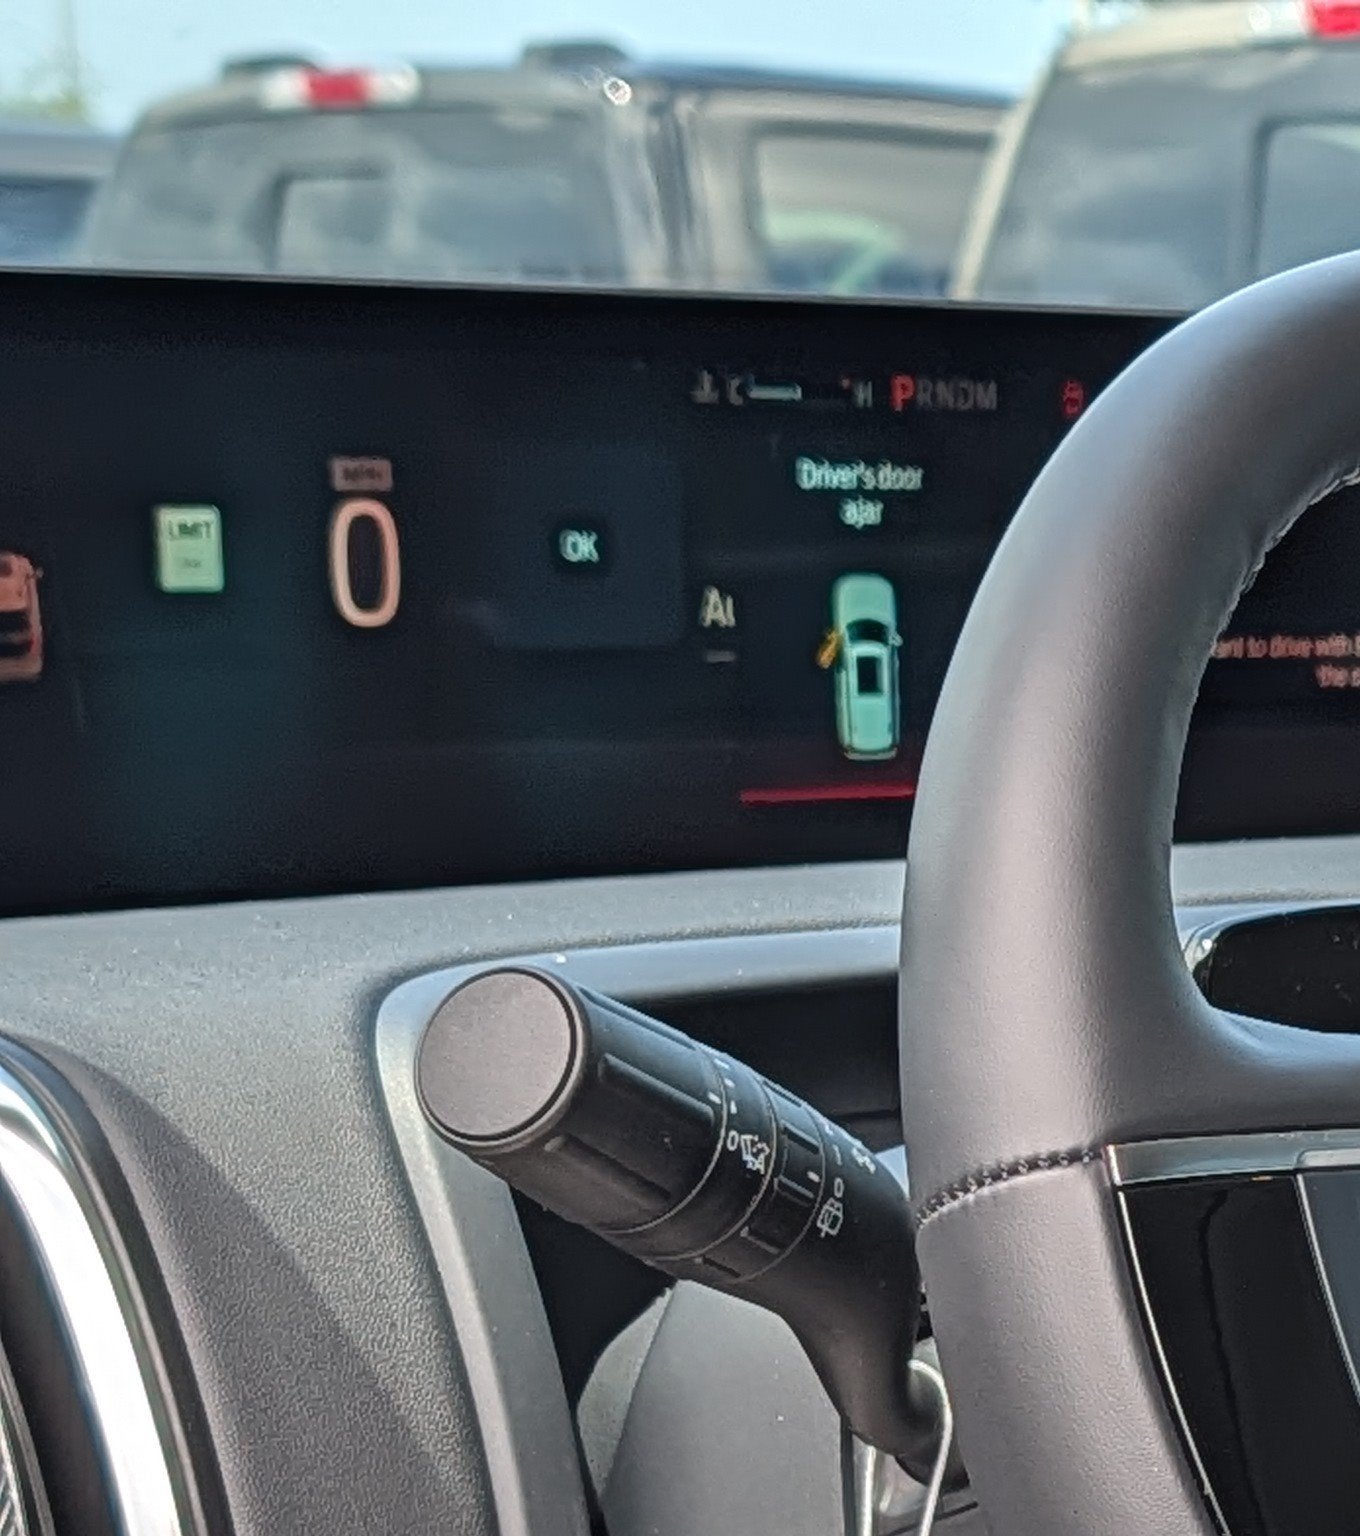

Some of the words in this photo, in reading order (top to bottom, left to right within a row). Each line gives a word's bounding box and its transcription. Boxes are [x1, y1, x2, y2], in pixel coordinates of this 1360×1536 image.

[796, 456, 875, 490] Driver's
[877, 458, 924, 490] door
[839, 496, 884, 530] ajar
[329, 498, 400, 628] 0
[559, 528, 600, 564] OK
